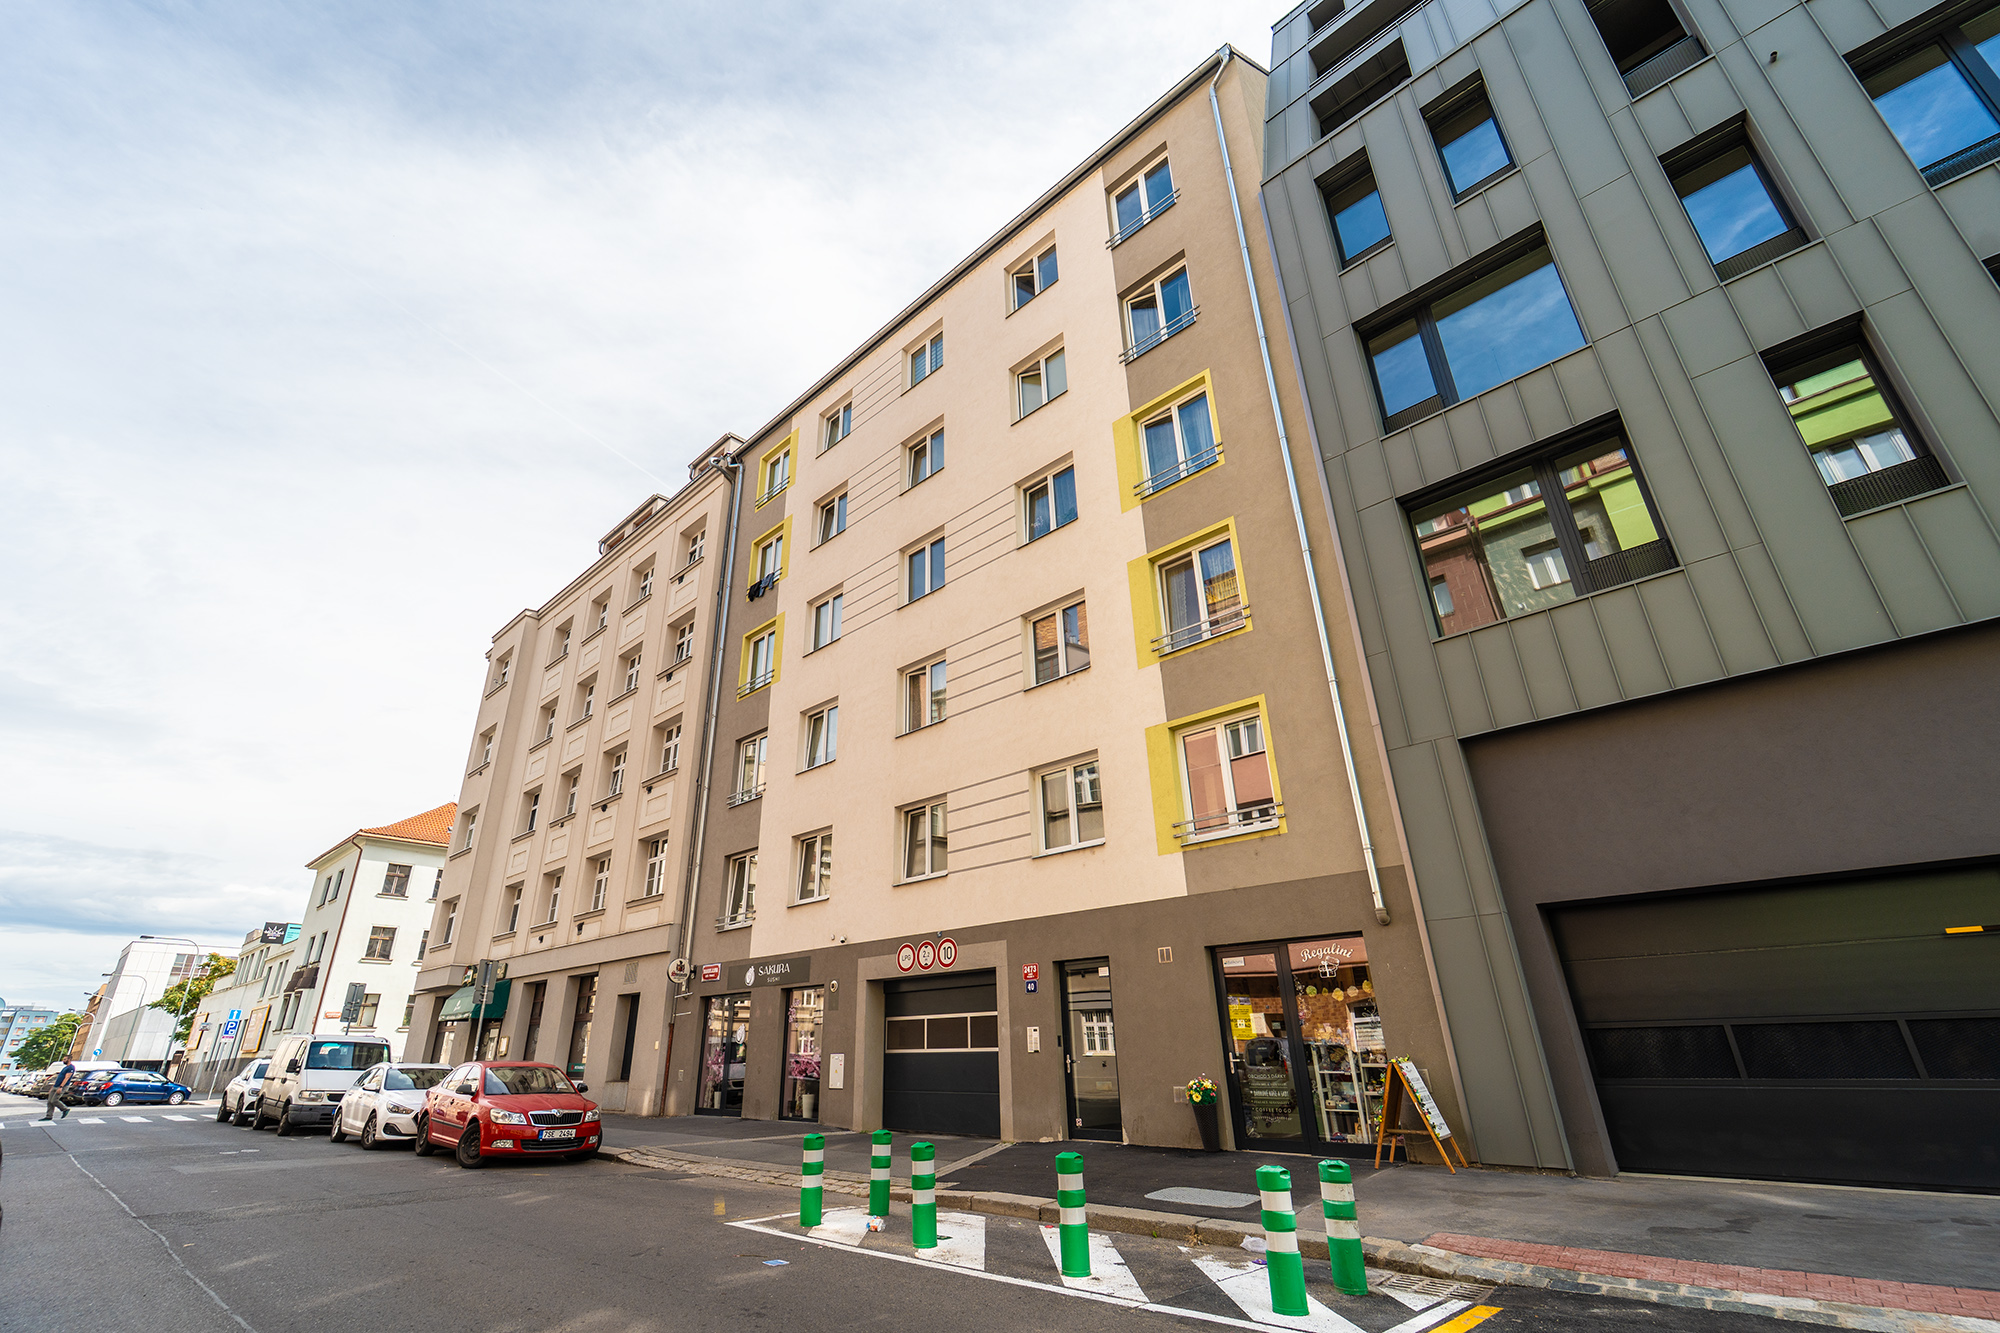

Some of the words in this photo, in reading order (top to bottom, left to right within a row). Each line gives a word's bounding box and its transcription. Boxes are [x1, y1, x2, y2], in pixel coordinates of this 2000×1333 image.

[943, 946, 952, 960] 10
[1301, 943, 1353, 962] Regalini
[758, 963, 790, 977] SAKURA
[227, 1022, 236, 1031] P
